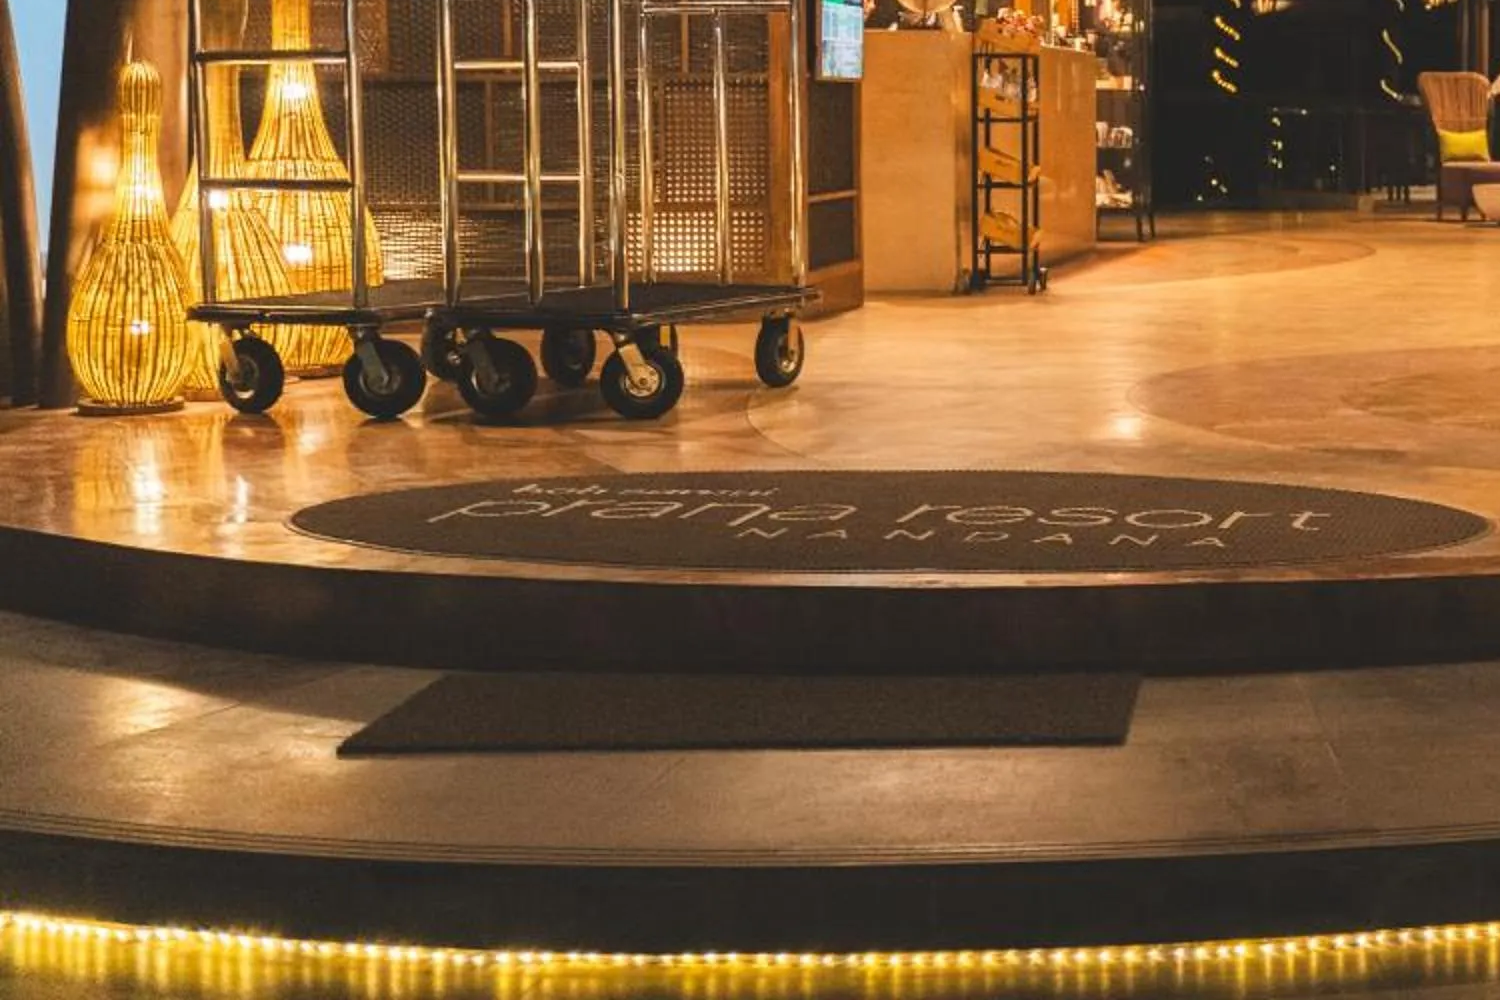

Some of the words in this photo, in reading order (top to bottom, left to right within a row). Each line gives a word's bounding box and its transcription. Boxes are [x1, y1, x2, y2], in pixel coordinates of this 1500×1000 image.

[428, 498, 858, 527] prana
[894, 503, 1332, 531] resort
[735, 526, 1226, 548] NANDANA
